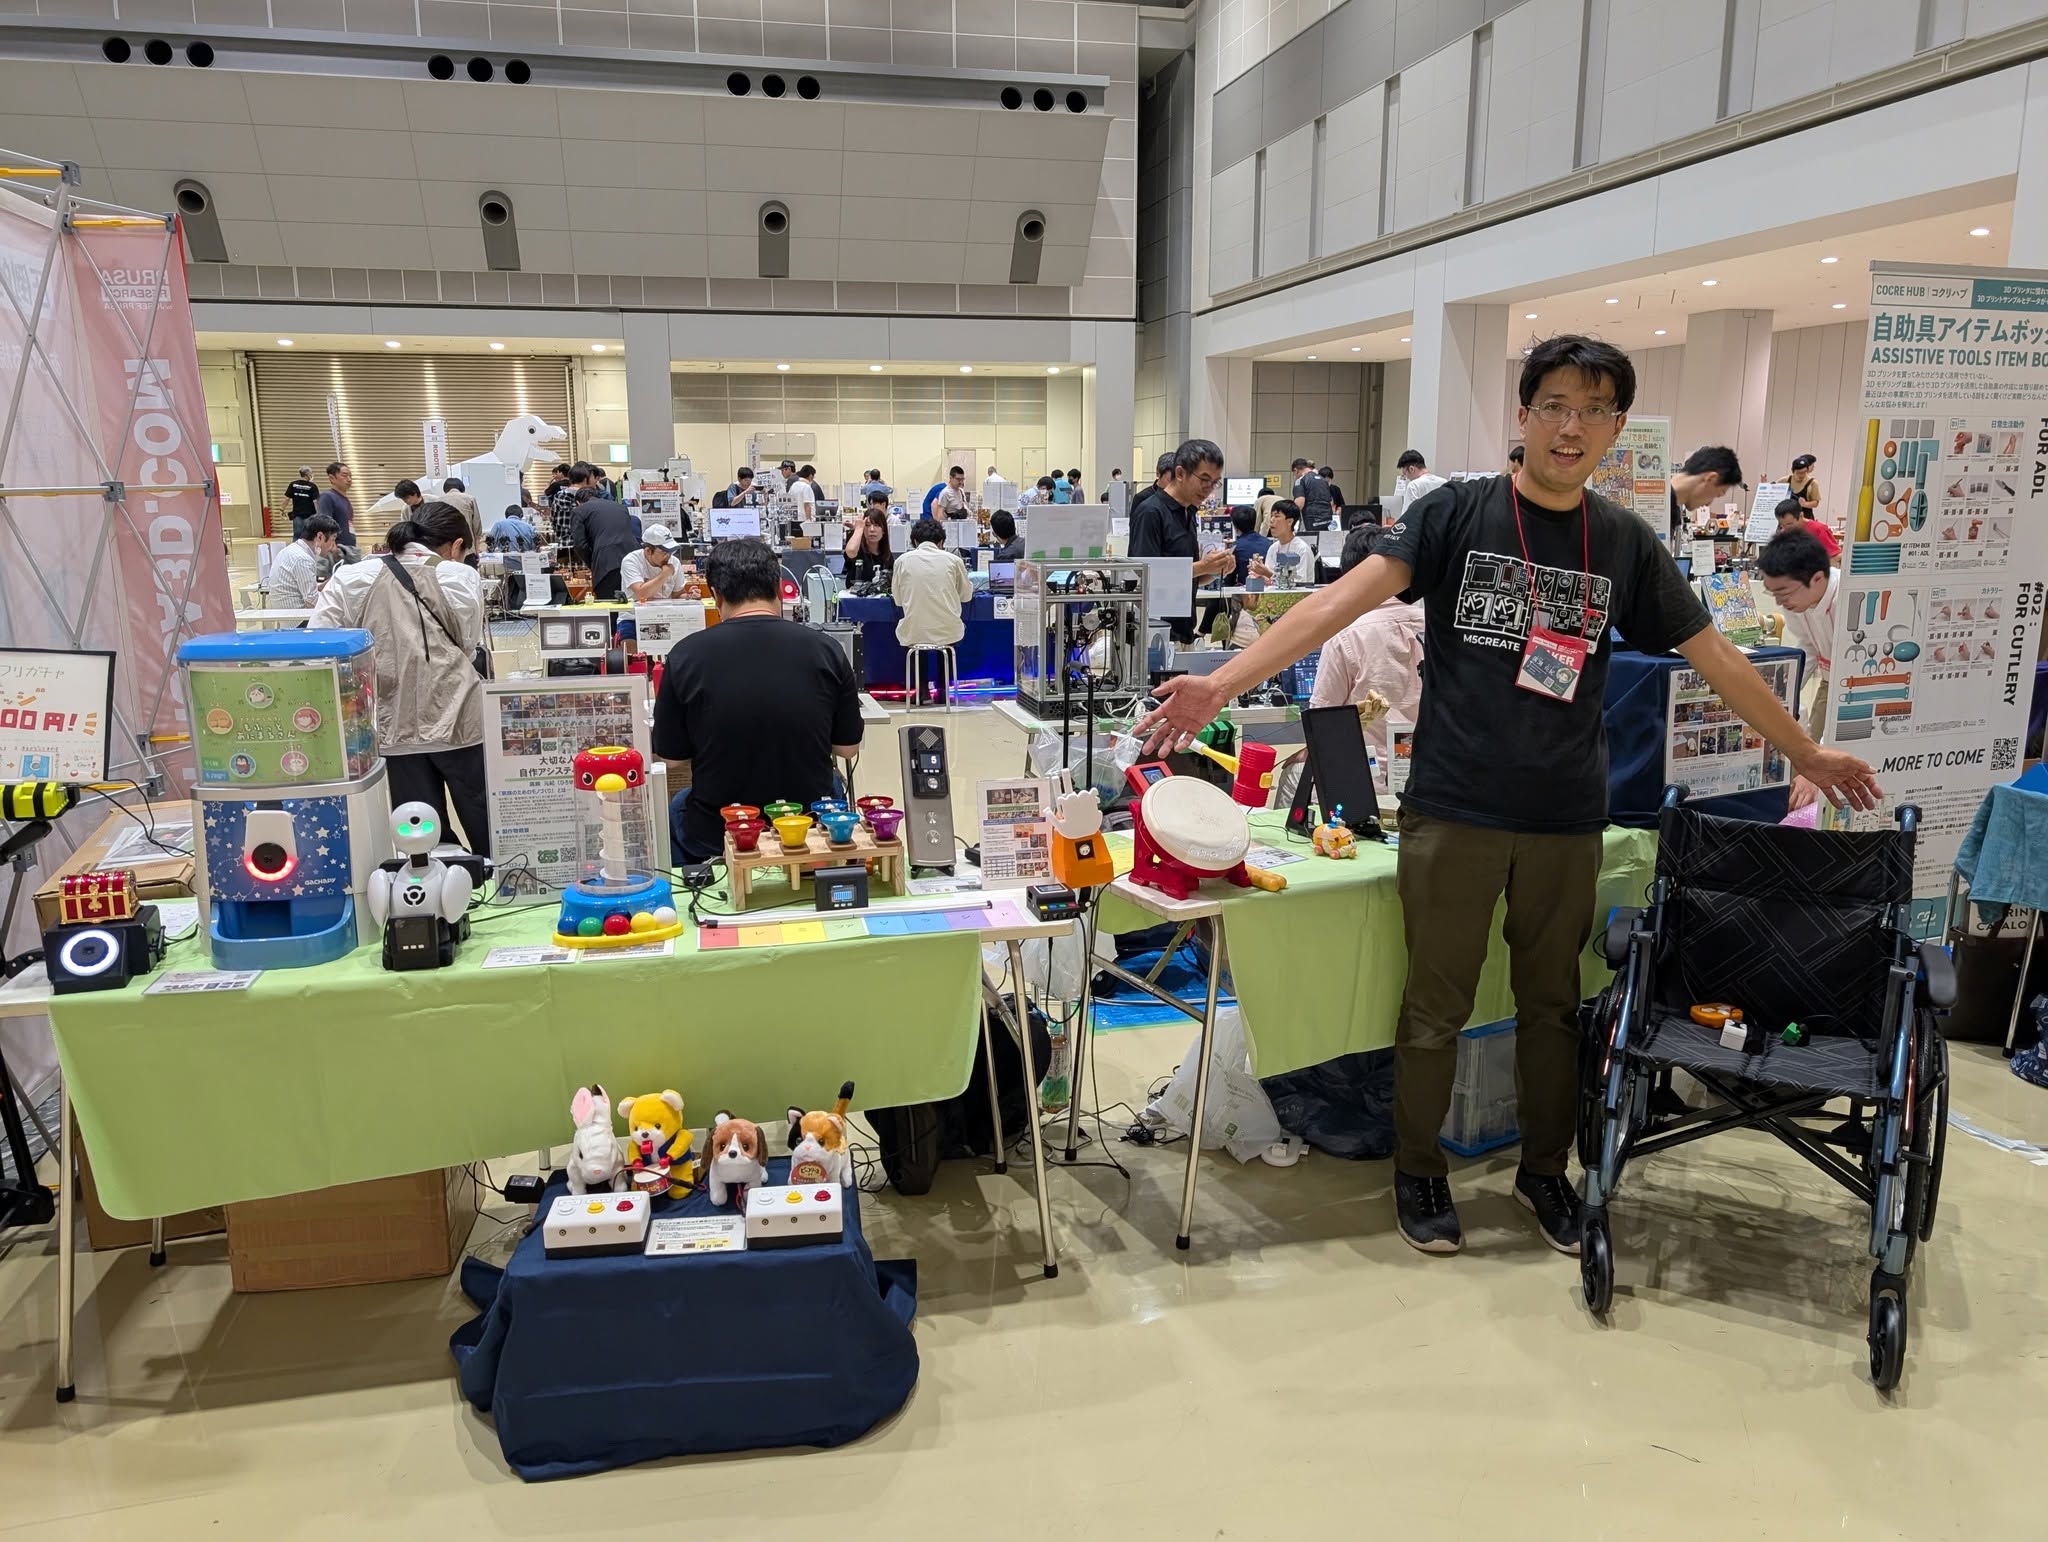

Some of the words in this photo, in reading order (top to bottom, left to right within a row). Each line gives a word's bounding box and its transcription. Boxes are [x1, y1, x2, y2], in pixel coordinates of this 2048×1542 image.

[1876, 284, 1905, 296] COCRE
[1906, 286, 1925, 297] HUB
[1931, 287, 1969, 299] コクリハブ
[1873, 312, 2048, 345] 自助具アイテムボッ
[1871, 347, 1944, 365] ASSISTIVE
[1949, 349, 1991, 366] TOOLS
[1995, 351, 2027, 367] ITEM
[2036, 418, 2048, 455] FOR
[2031, 461, 2047, 499] ADL
[1462, 593, 1485, 614] M5
[1491, 596, 1516, 617] M5
[2014, 583, 2031, 618] FOR
[2030, 582, 2044, 616] #02
[1463, 634, 1521, 652] M5CREATE
[2003, 624, 2025, 706] CUTLERY
[1927, 752, 1942, 767] TO
[1945, 748, 1985, 766] COME
[519, 767, 574, 777] 自作アシステ
[1976, 920, 2028, 931] CAALO
